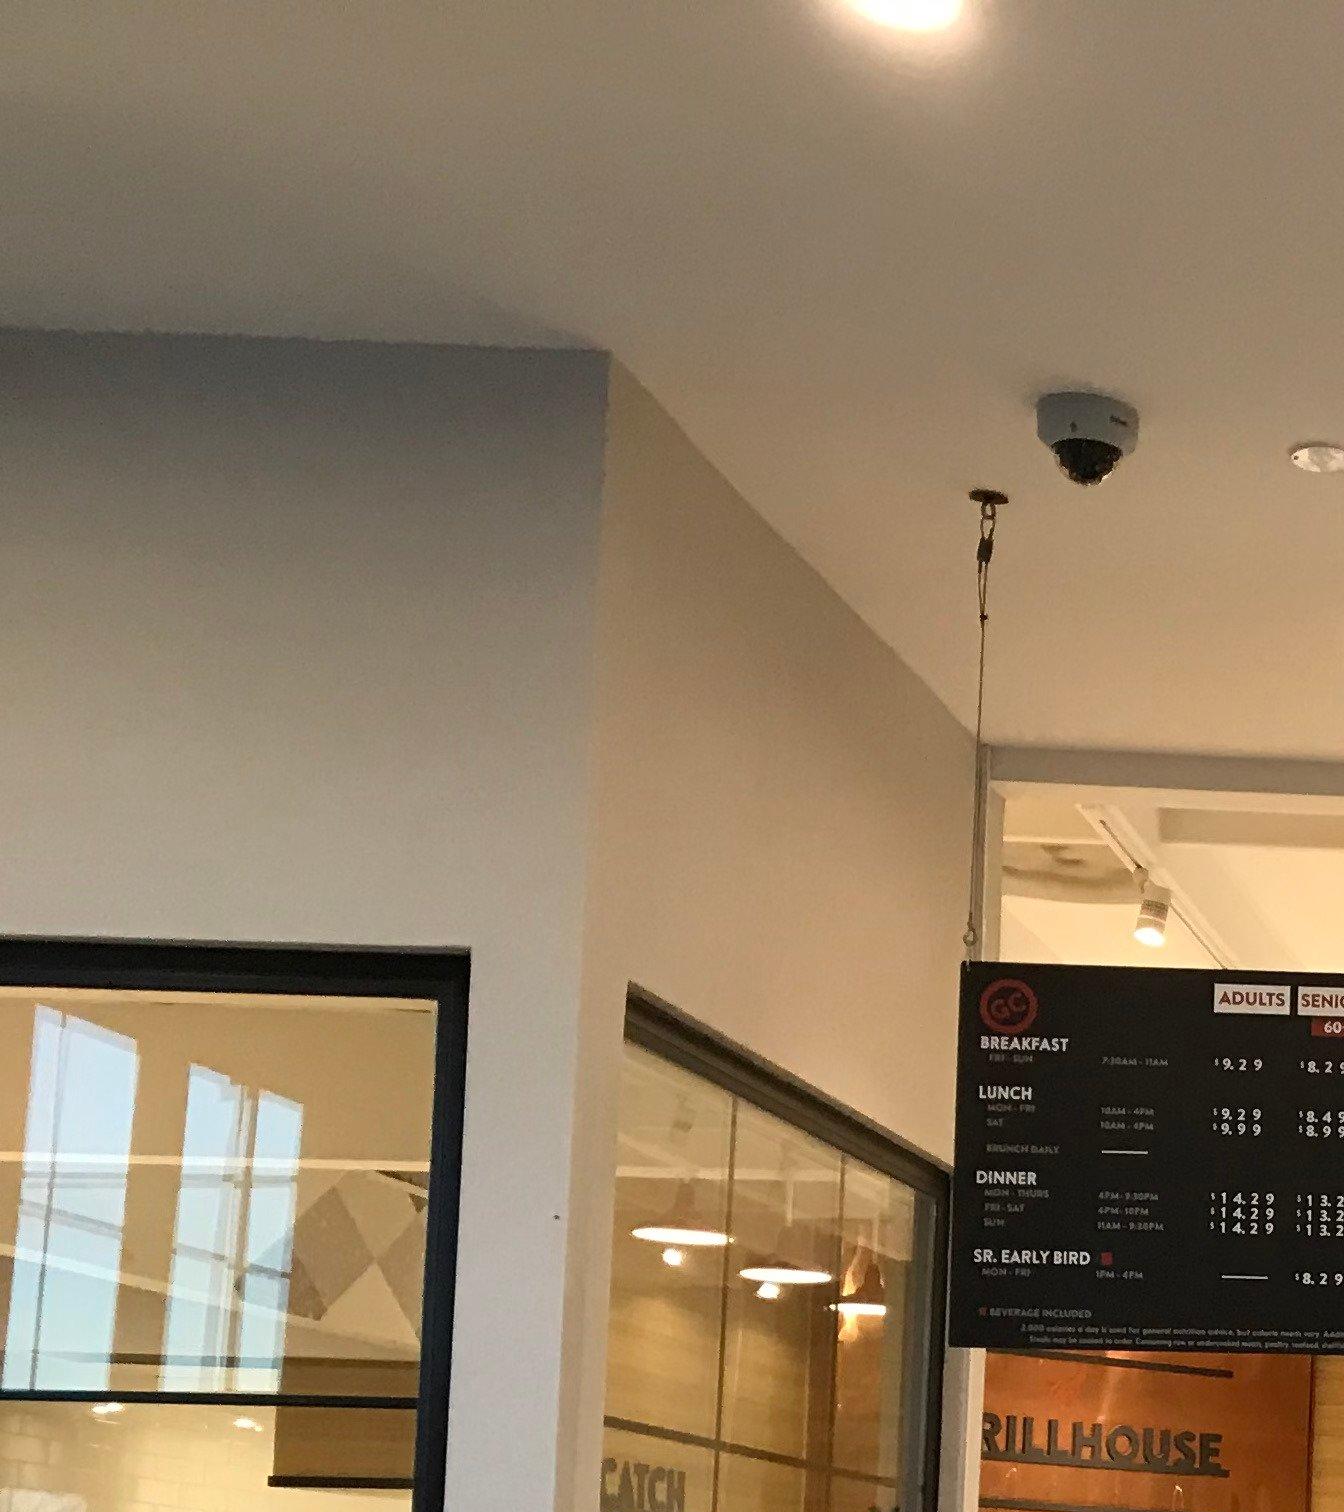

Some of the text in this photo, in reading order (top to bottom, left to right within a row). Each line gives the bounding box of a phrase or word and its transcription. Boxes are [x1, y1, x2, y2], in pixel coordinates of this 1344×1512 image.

[1219, 991, 1285, 1007] ADULTS
[980, 1035, 1069, 1052] BREAKFAST
[979, 1085, 1033, 1101] LUNCH
[976, 1170, 1037, 1186] DINNER
[973, 1248, 1091, 1265] SR. EARLY BIRD
[990, 1308, 1092, 1318] BEVERAGE INCLUDED
[981, 1412, 1223, 1467] RILLHOUSE
